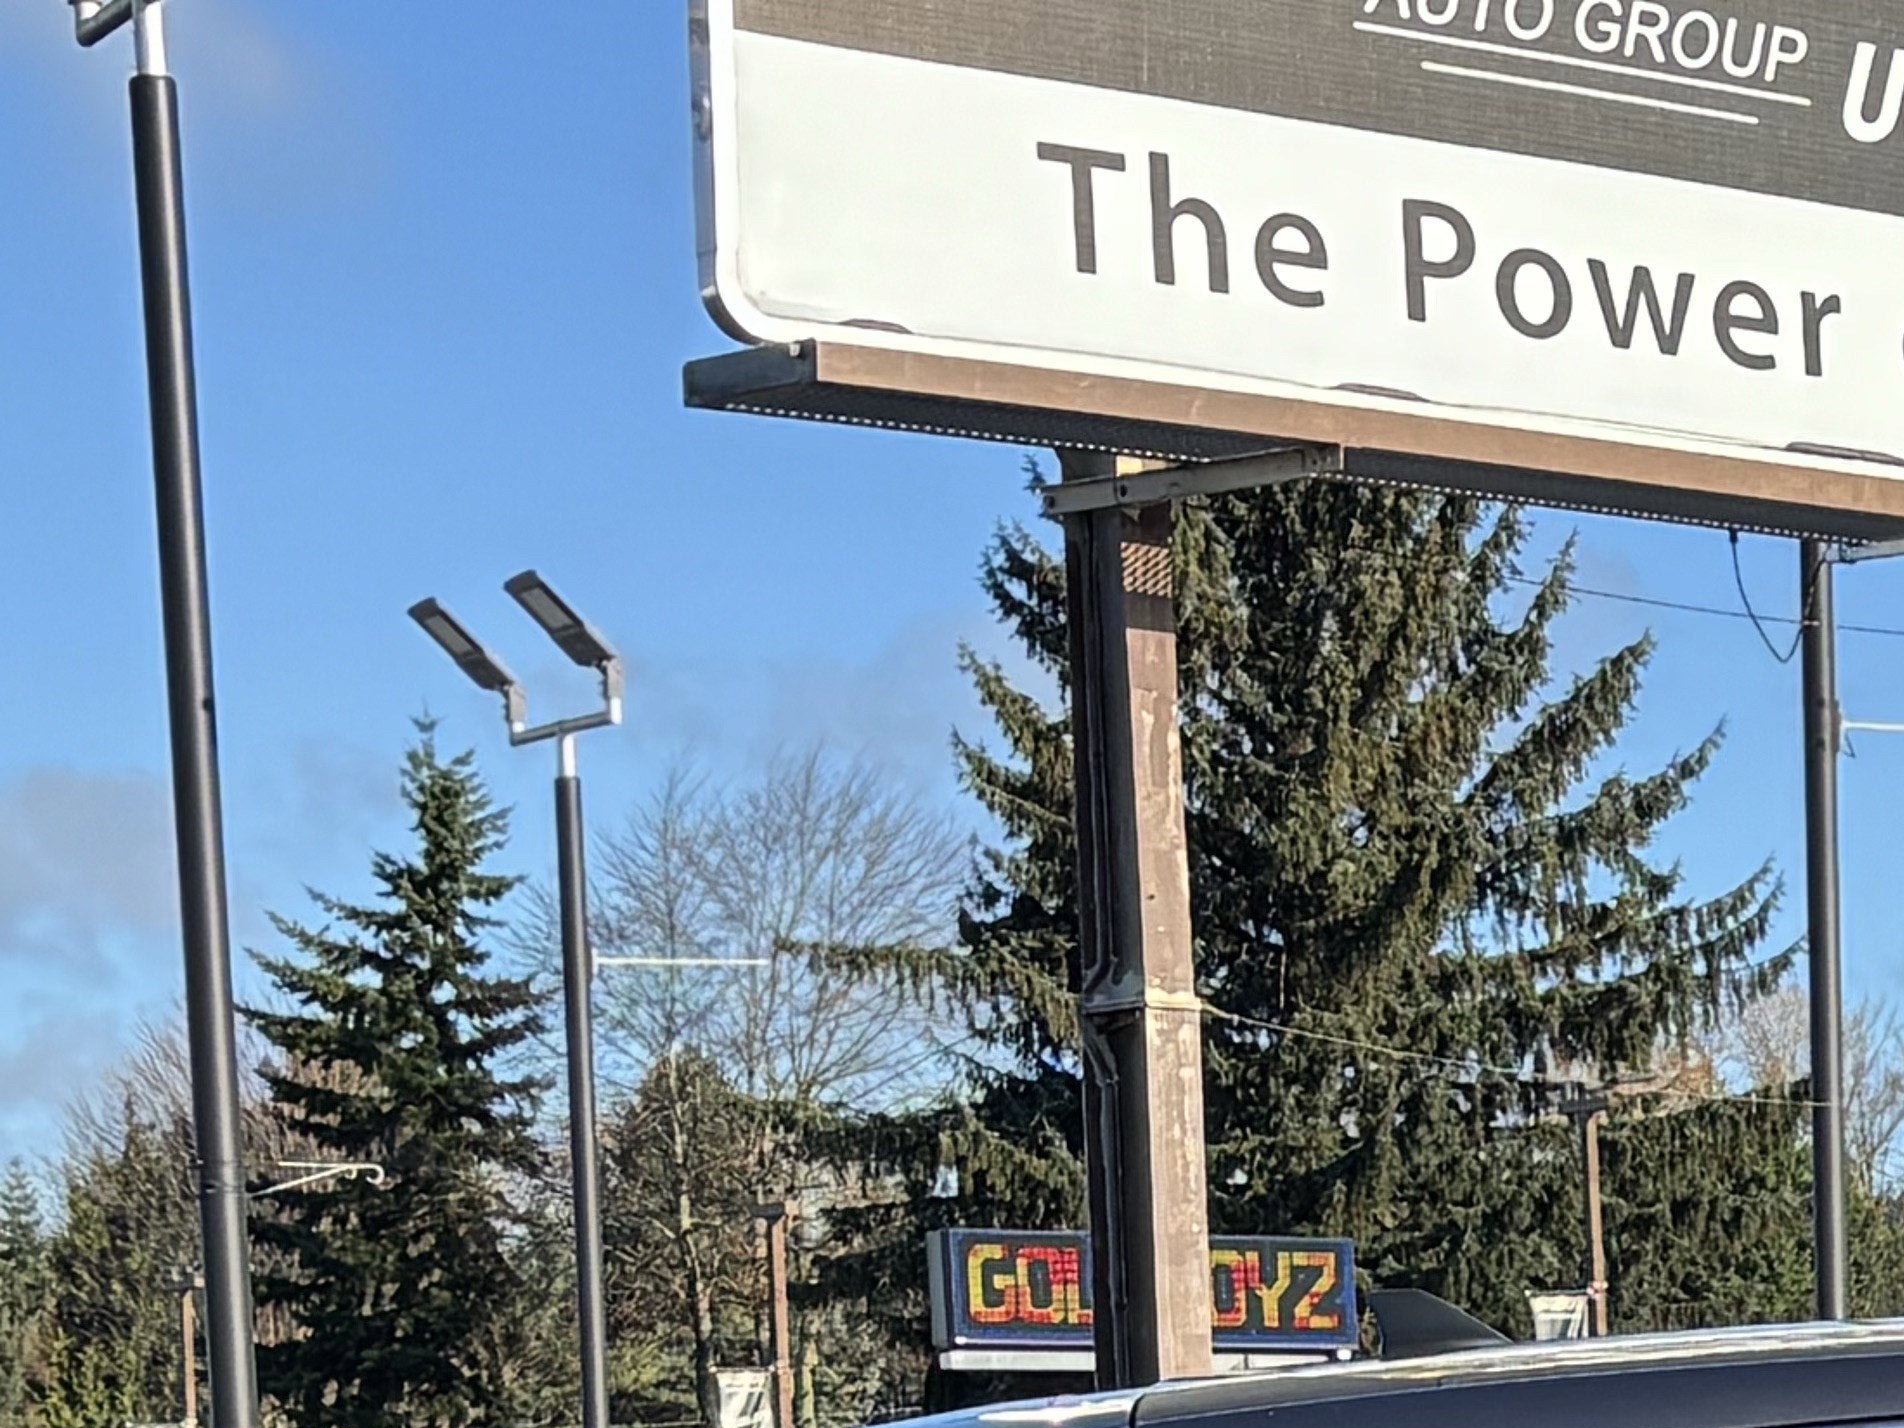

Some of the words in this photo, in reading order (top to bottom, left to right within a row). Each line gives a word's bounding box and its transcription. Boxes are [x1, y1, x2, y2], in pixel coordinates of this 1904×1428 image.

[1363, 0, 1553, 40] TO
[1574, 0, 1808, 82] GROUP
[1036, 141, 1328, 307] The
[1402, 198, 1841, 376] Power
